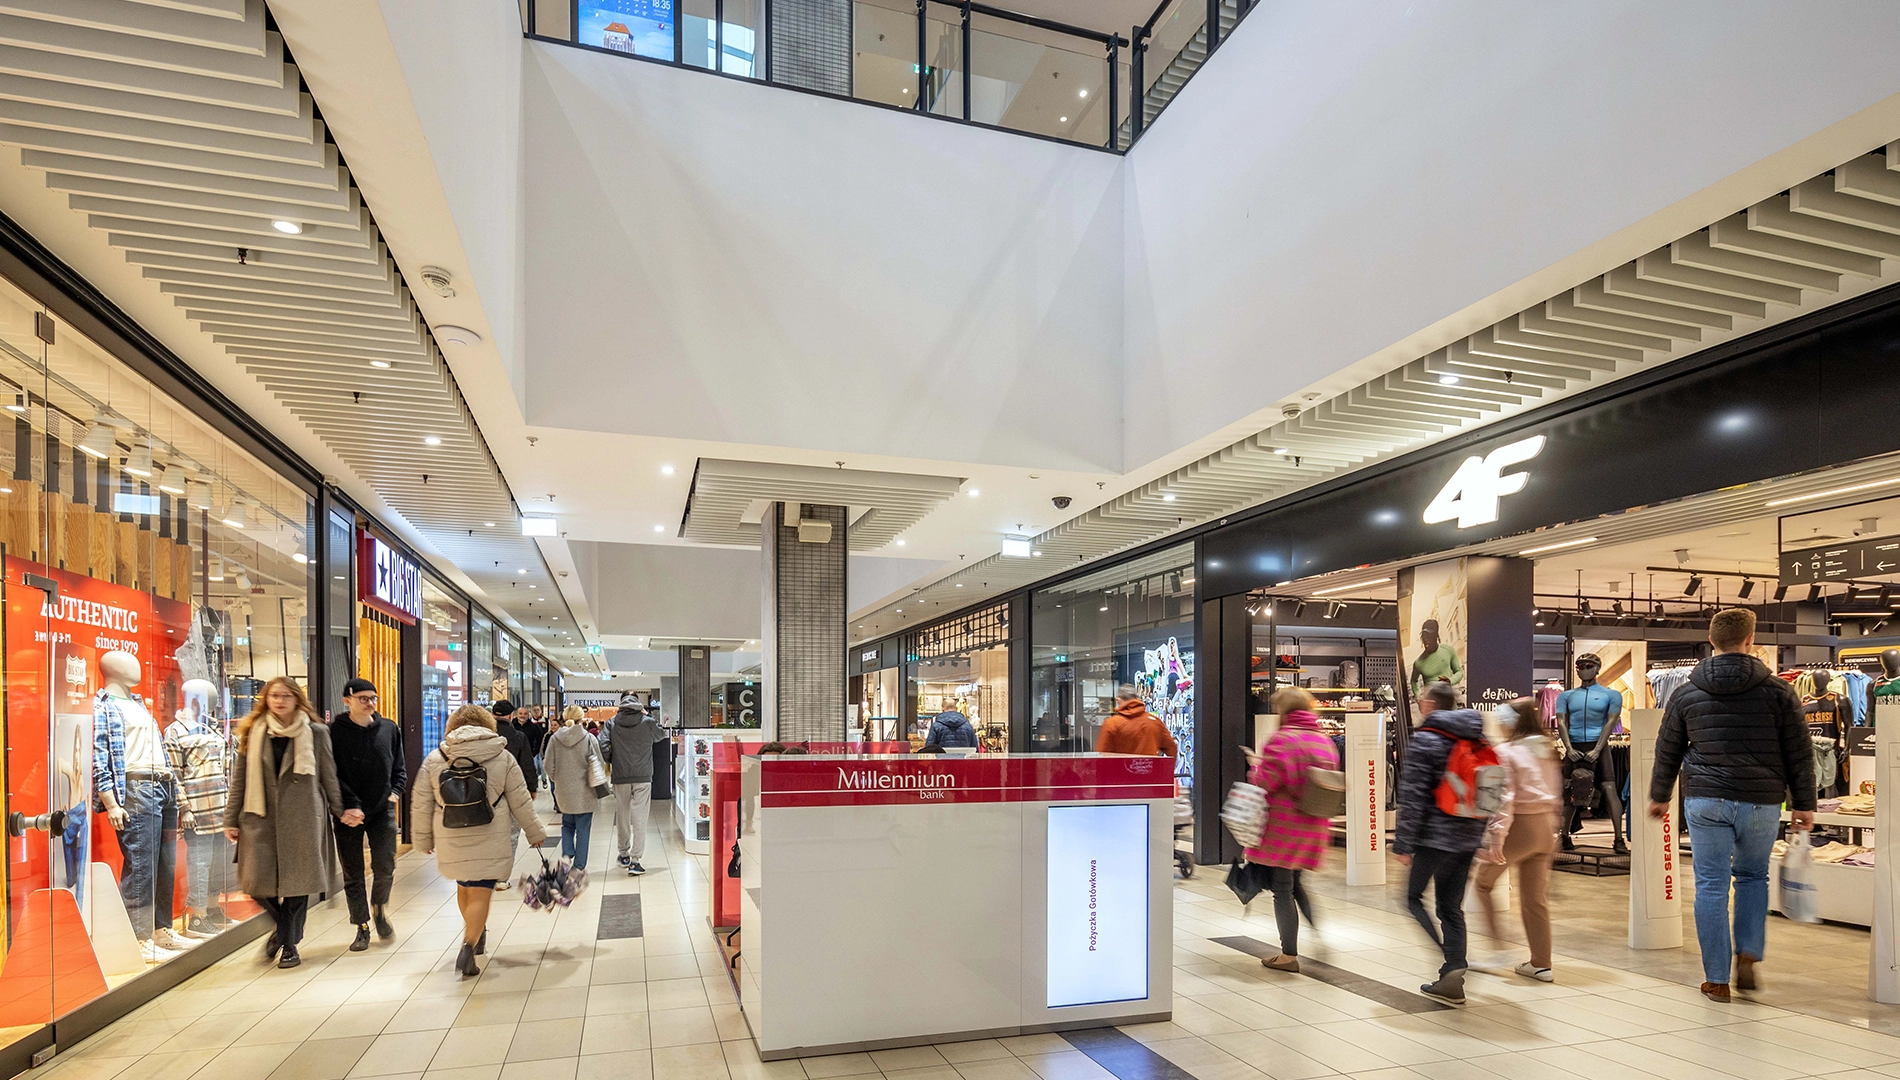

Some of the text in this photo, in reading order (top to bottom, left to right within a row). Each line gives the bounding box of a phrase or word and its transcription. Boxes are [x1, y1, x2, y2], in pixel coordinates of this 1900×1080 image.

[1423, 435, 1547, 528] 4F
[391, 550, 423, 620] BIG STAR
[40, 595, 138, 633] AUTHENTIC
[95, 632, 139, 655] since 1979
[1165, 713, 1189, 727] GAME
[837, 766, 955, 789] Millennium
[1368, 760, 1376, 786] SALE
[919, 789, 945, 799] bank
[1369, 788, 1377, 831] SEASON
[1663, 813, 1673, 900] MID SEASON
[1089, 859, 1098, 951] Pożyczka Gotówkowa
